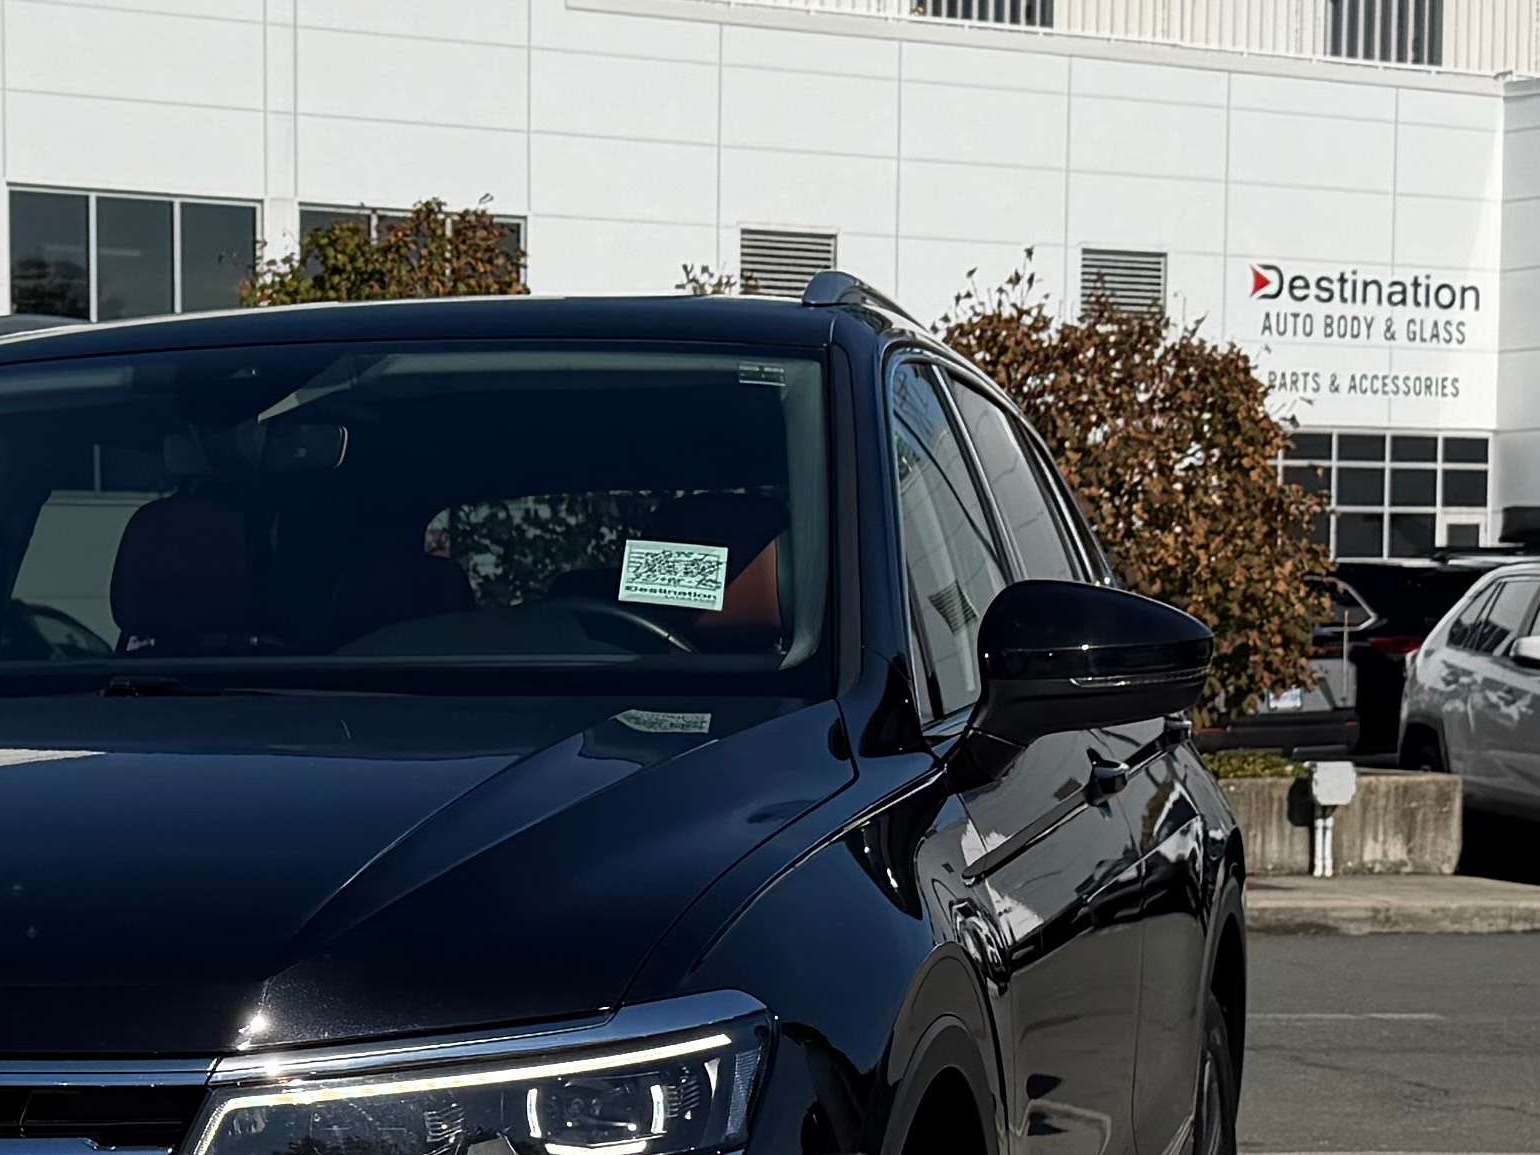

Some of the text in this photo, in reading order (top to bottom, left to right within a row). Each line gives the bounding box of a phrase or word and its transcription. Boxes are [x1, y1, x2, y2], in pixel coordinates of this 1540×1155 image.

[1250, 264, 1480, 311] Destination
[1261, 311, 1466, 344] AUTO BODY & GLASS
[1267, 371, 1460, 398] PARTS & ACCESSORIES
